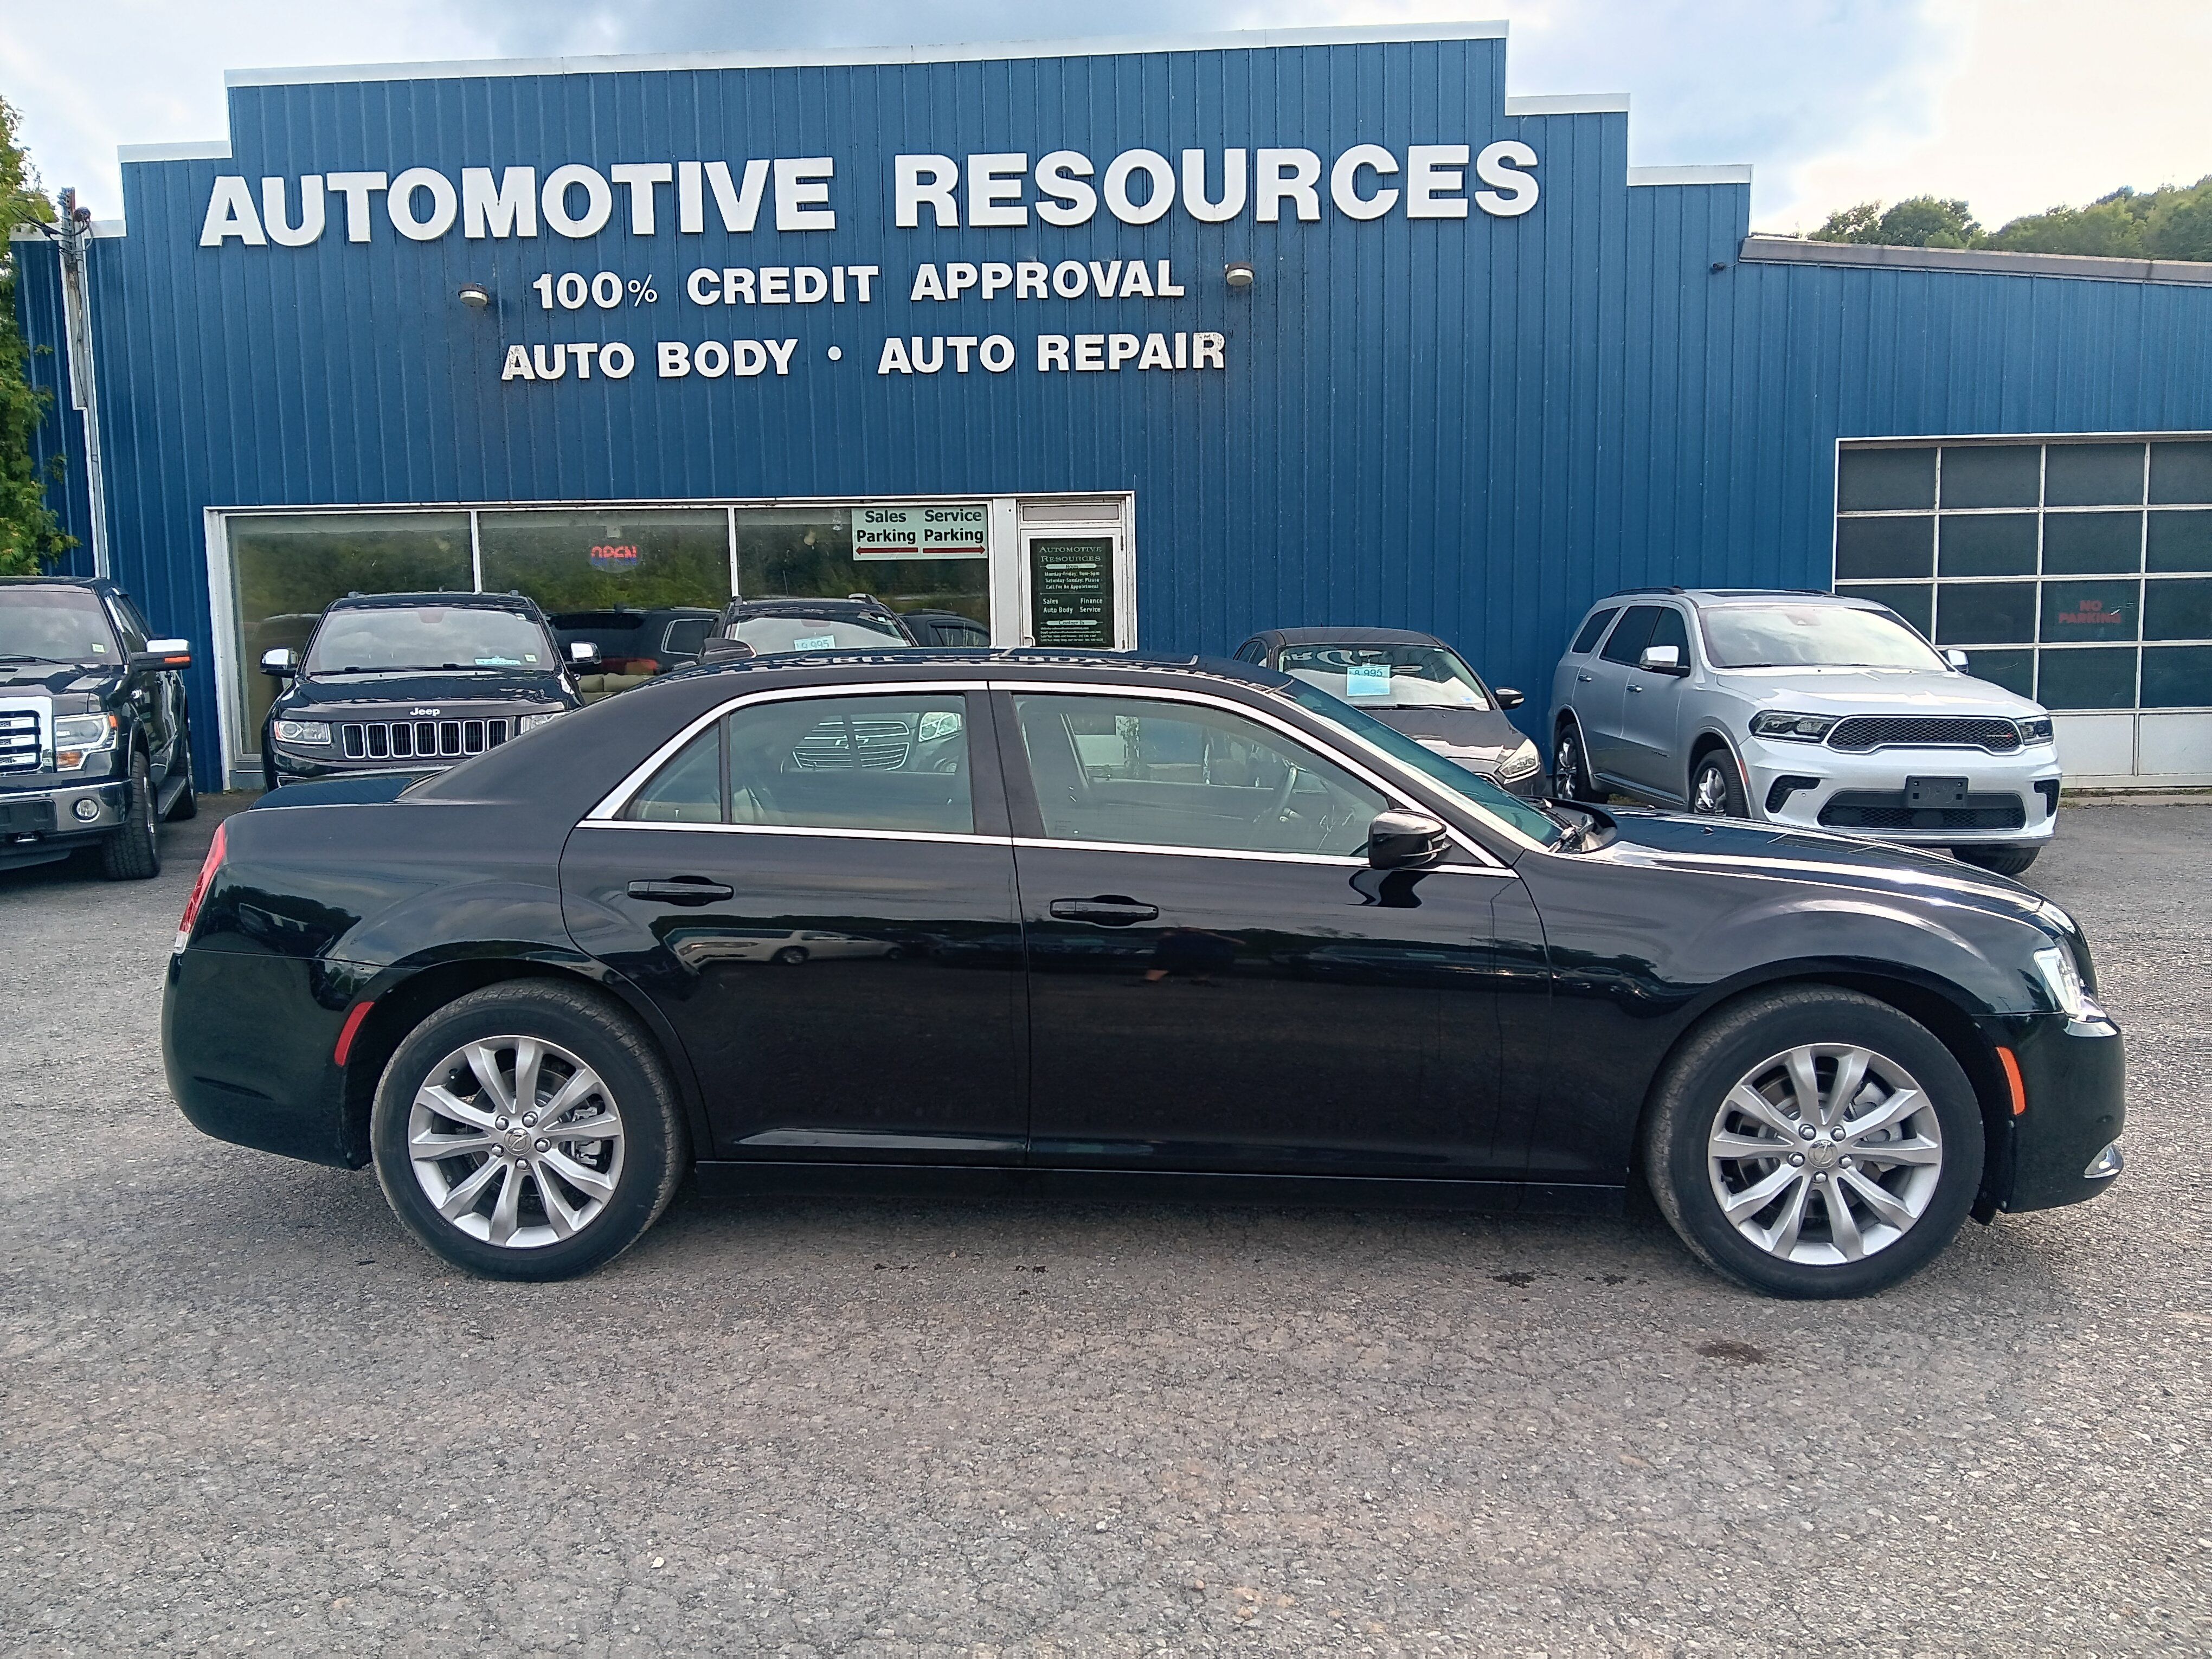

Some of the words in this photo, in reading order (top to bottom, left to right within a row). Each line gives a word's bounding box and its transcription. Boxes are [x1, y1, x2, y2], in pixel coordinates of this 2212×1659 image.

[198, 156, 836, 247] AUTOMOTIVE
[895, 140, 1540, 228] RESOURCES
[532, 272, 658, 310] 100%
[687, 265, 879, 306] CREDIT
[910, 260, 1185, 301] APPROVAL
[501, 342, 635, 381] AUTO
[657, 338, 799, 379] BODY
[877, 335, 1015, 375] AUTO
[1037, 332, 1226, 372] REPAIR
[865, 510, 906, 523] Sales
[924, 509, 982, 522] Service
[857, 529, 916, 545] Parking
[924, 528, 983, 543] Parking
[2079, 600, 2103, 612] NO
[409, 707, 440, 717] Jeep
